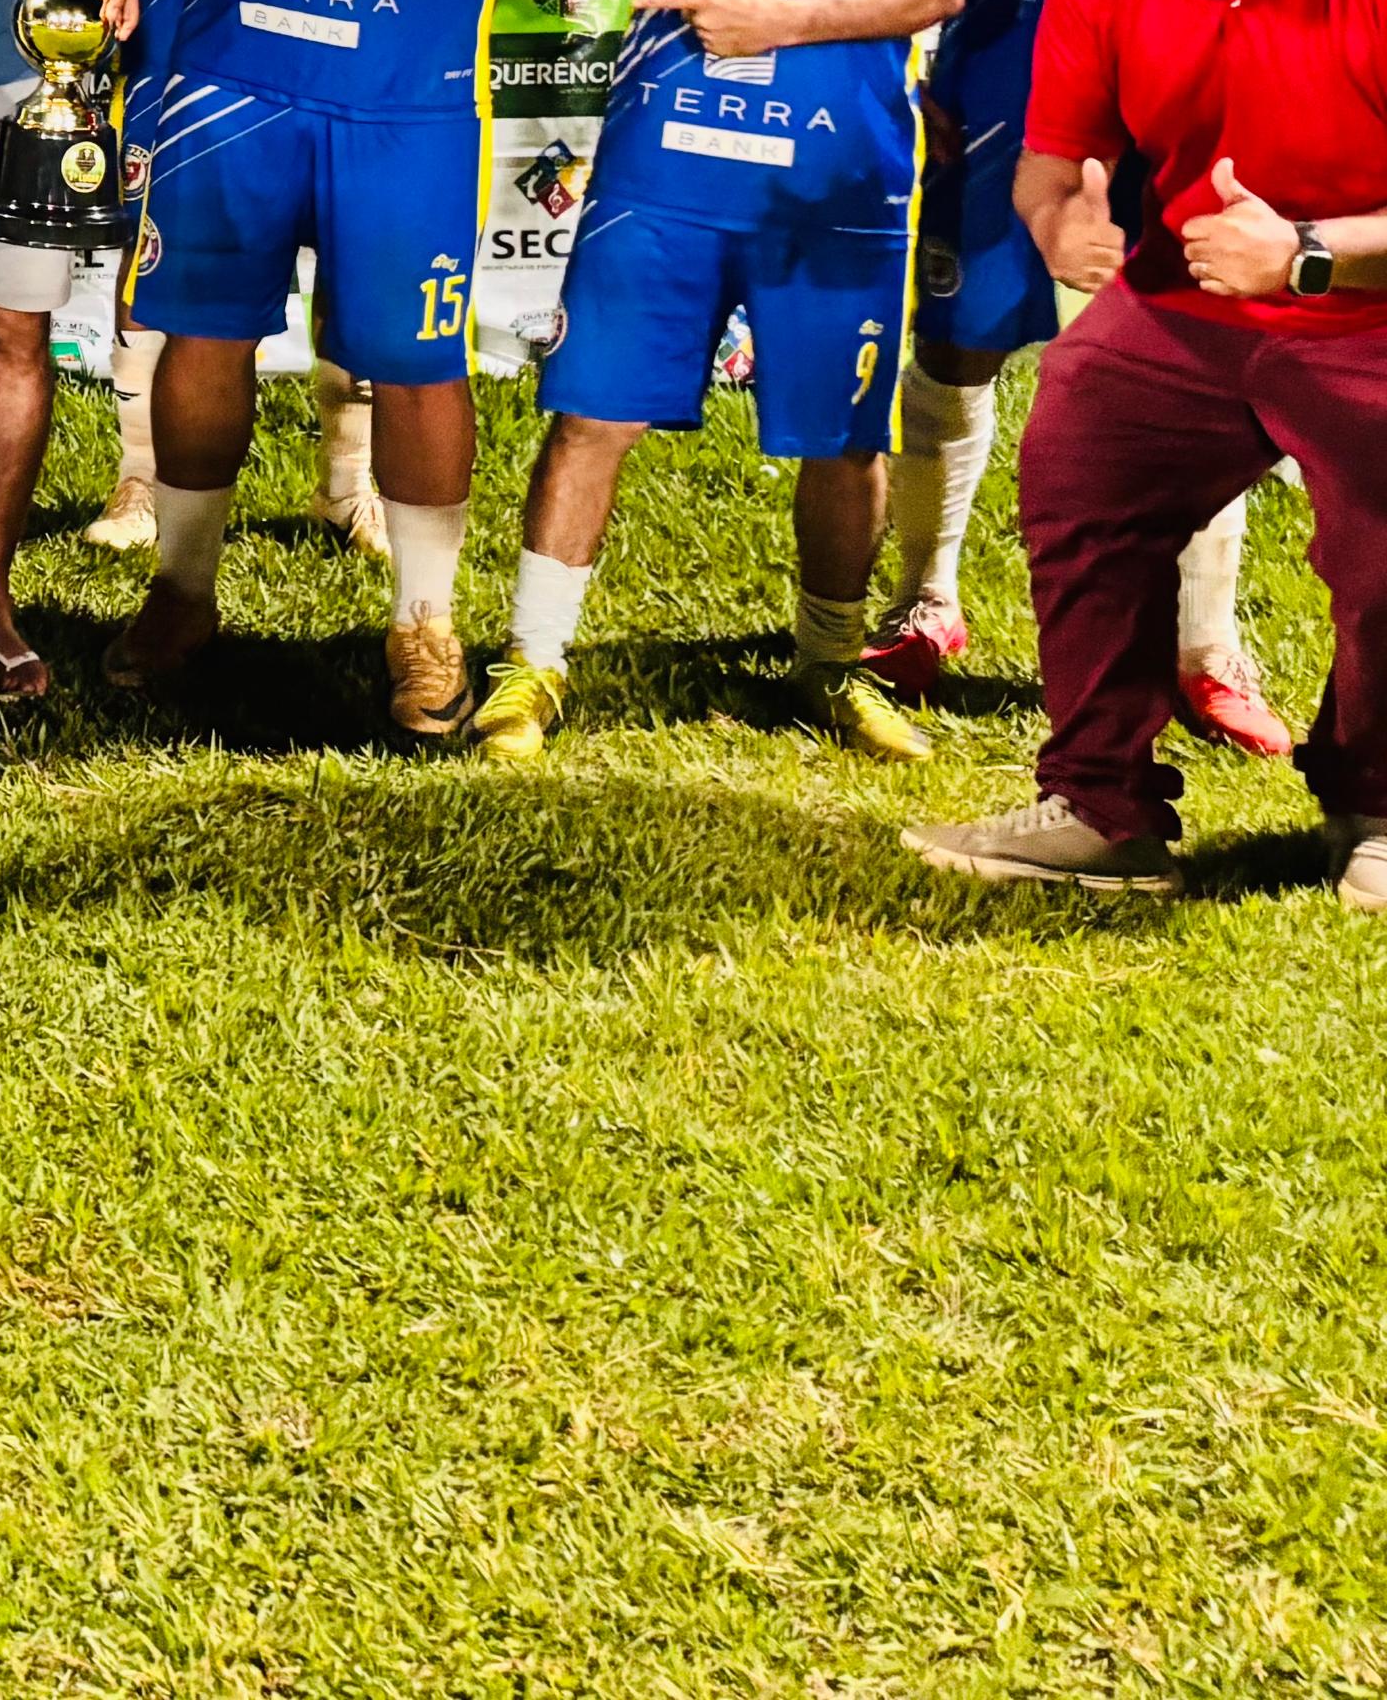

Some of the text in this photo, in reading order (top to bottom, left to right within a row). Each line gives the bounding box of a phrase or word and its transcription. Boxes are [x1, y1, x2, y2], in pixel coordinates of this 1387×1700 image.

[253, 9, 347, 42] BANK
[489, 56, 615, 90] QUERÊNCI
[638, 82, 837, 133] TERRA
[678, 129, 779, 159] BANK
[492, 228, 571, 260] SEC
[416, 274, 467, 341] 15
[852, 340, 878, 405] 9
